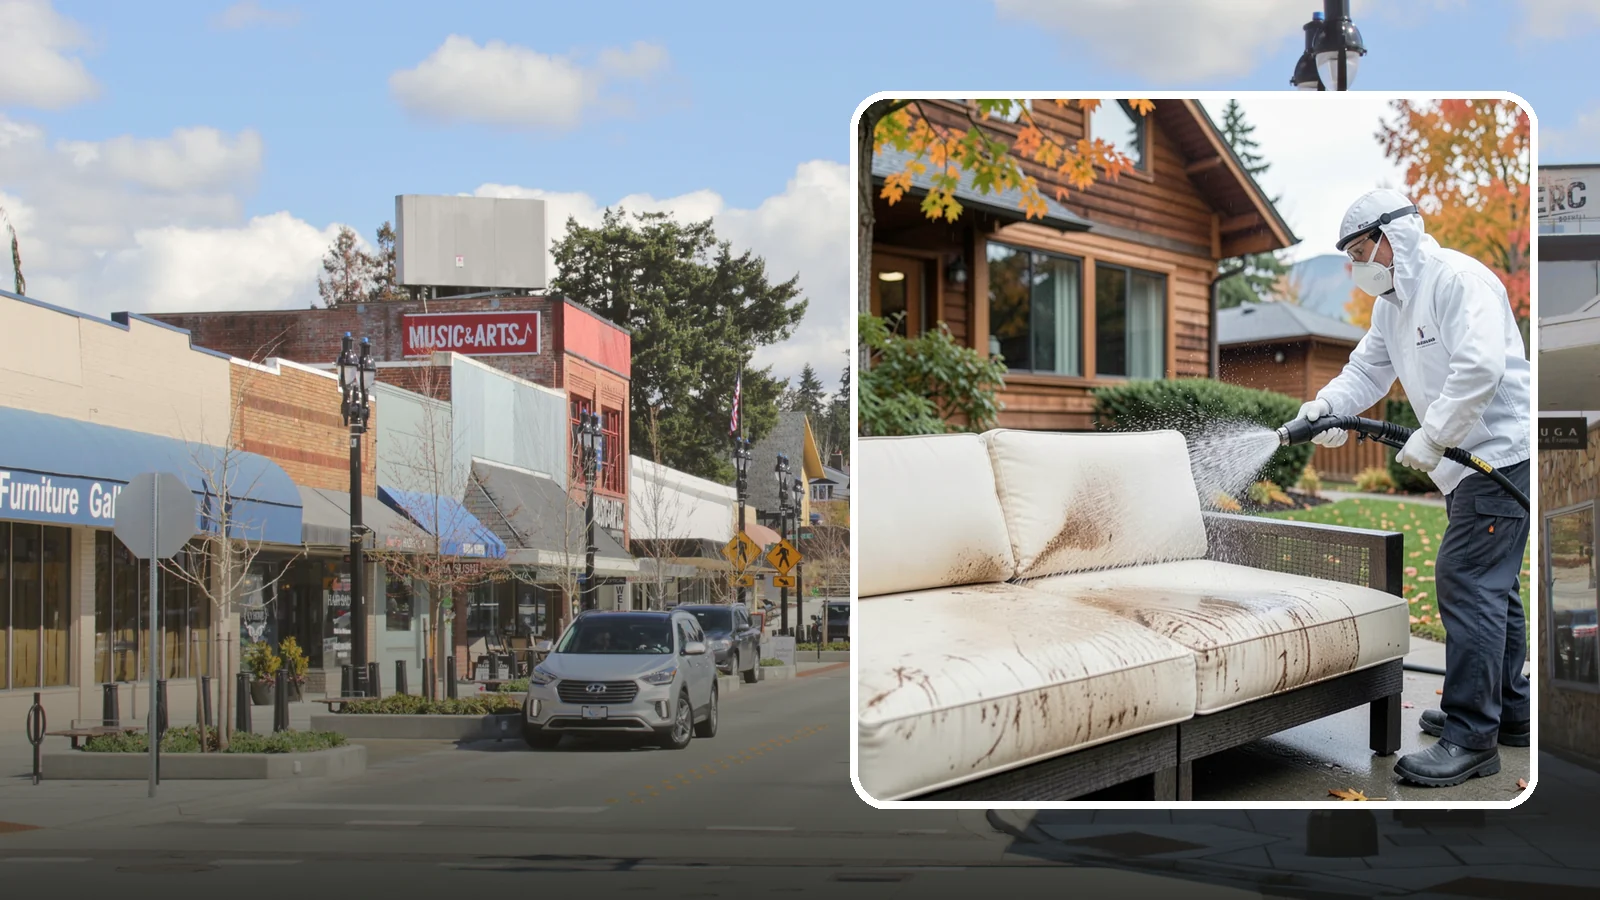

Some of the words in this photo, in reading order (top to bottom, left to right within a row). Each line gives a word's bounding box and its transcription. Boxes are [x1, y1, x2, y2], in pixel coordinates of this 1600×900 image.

[0, 471, 79, 515] Furniture
[89, 482, 122, 519] Gal
[453, 563, 479, 575] SUSHI
